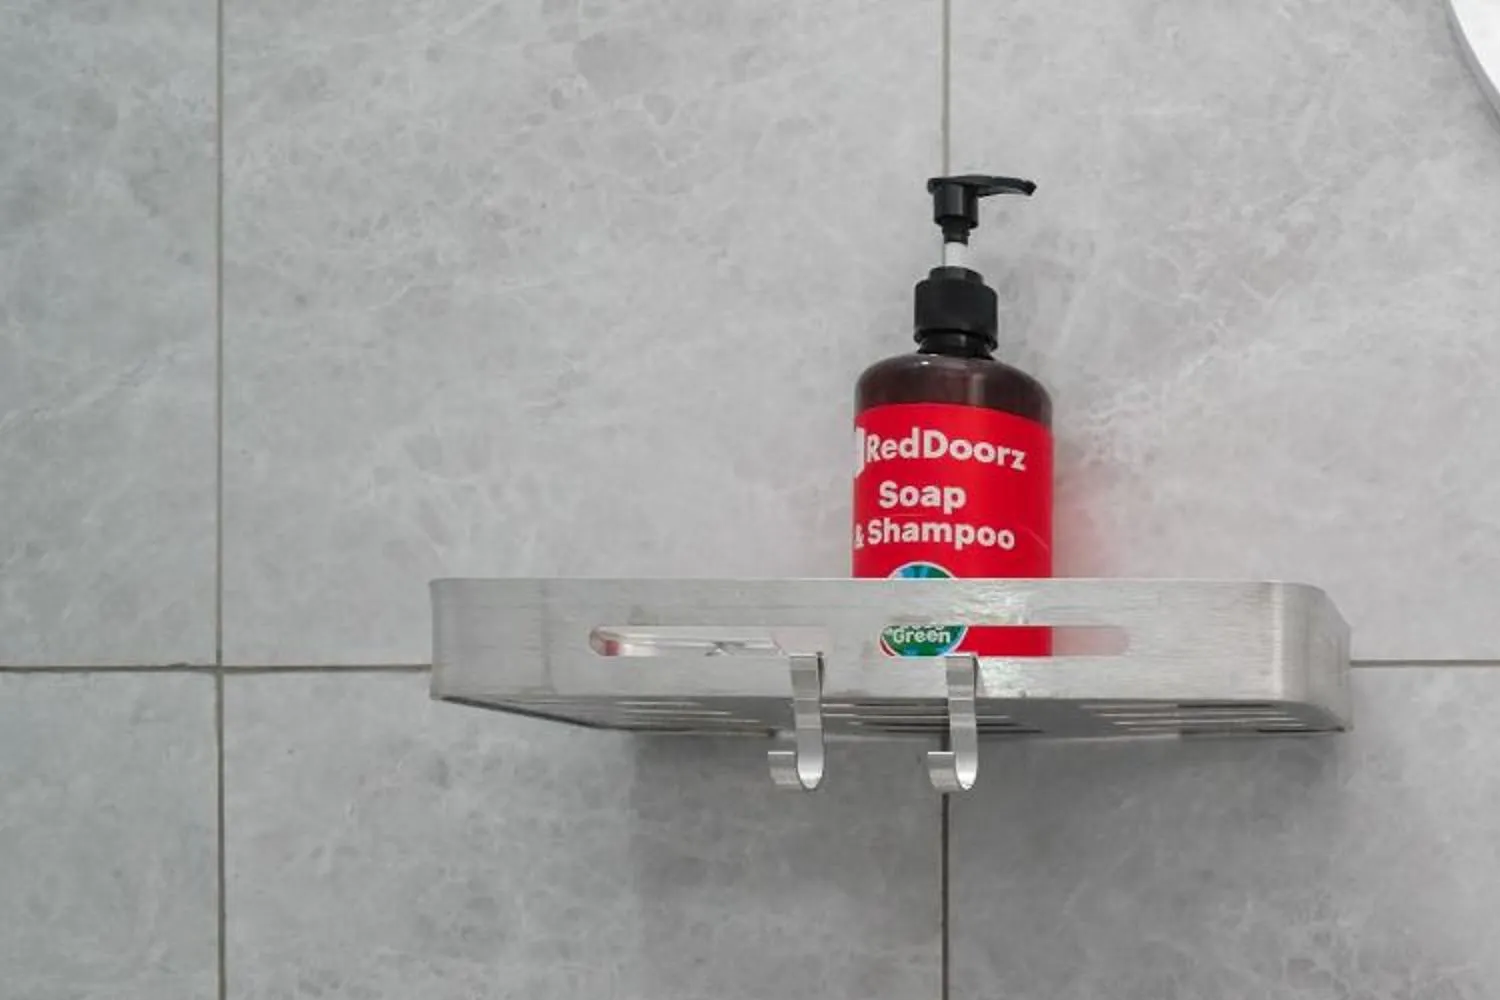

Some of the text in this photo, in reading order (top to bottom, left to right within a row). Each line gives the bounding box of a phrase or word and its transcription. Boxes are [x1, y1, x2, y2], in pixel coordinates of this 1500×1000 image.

[867, 427, 1026, 471] RedDoorz
[879, 480, 967, 514] Soap
[867, 517, 1016, 550] Shampoo
[893, 628, 951, 644] Green
